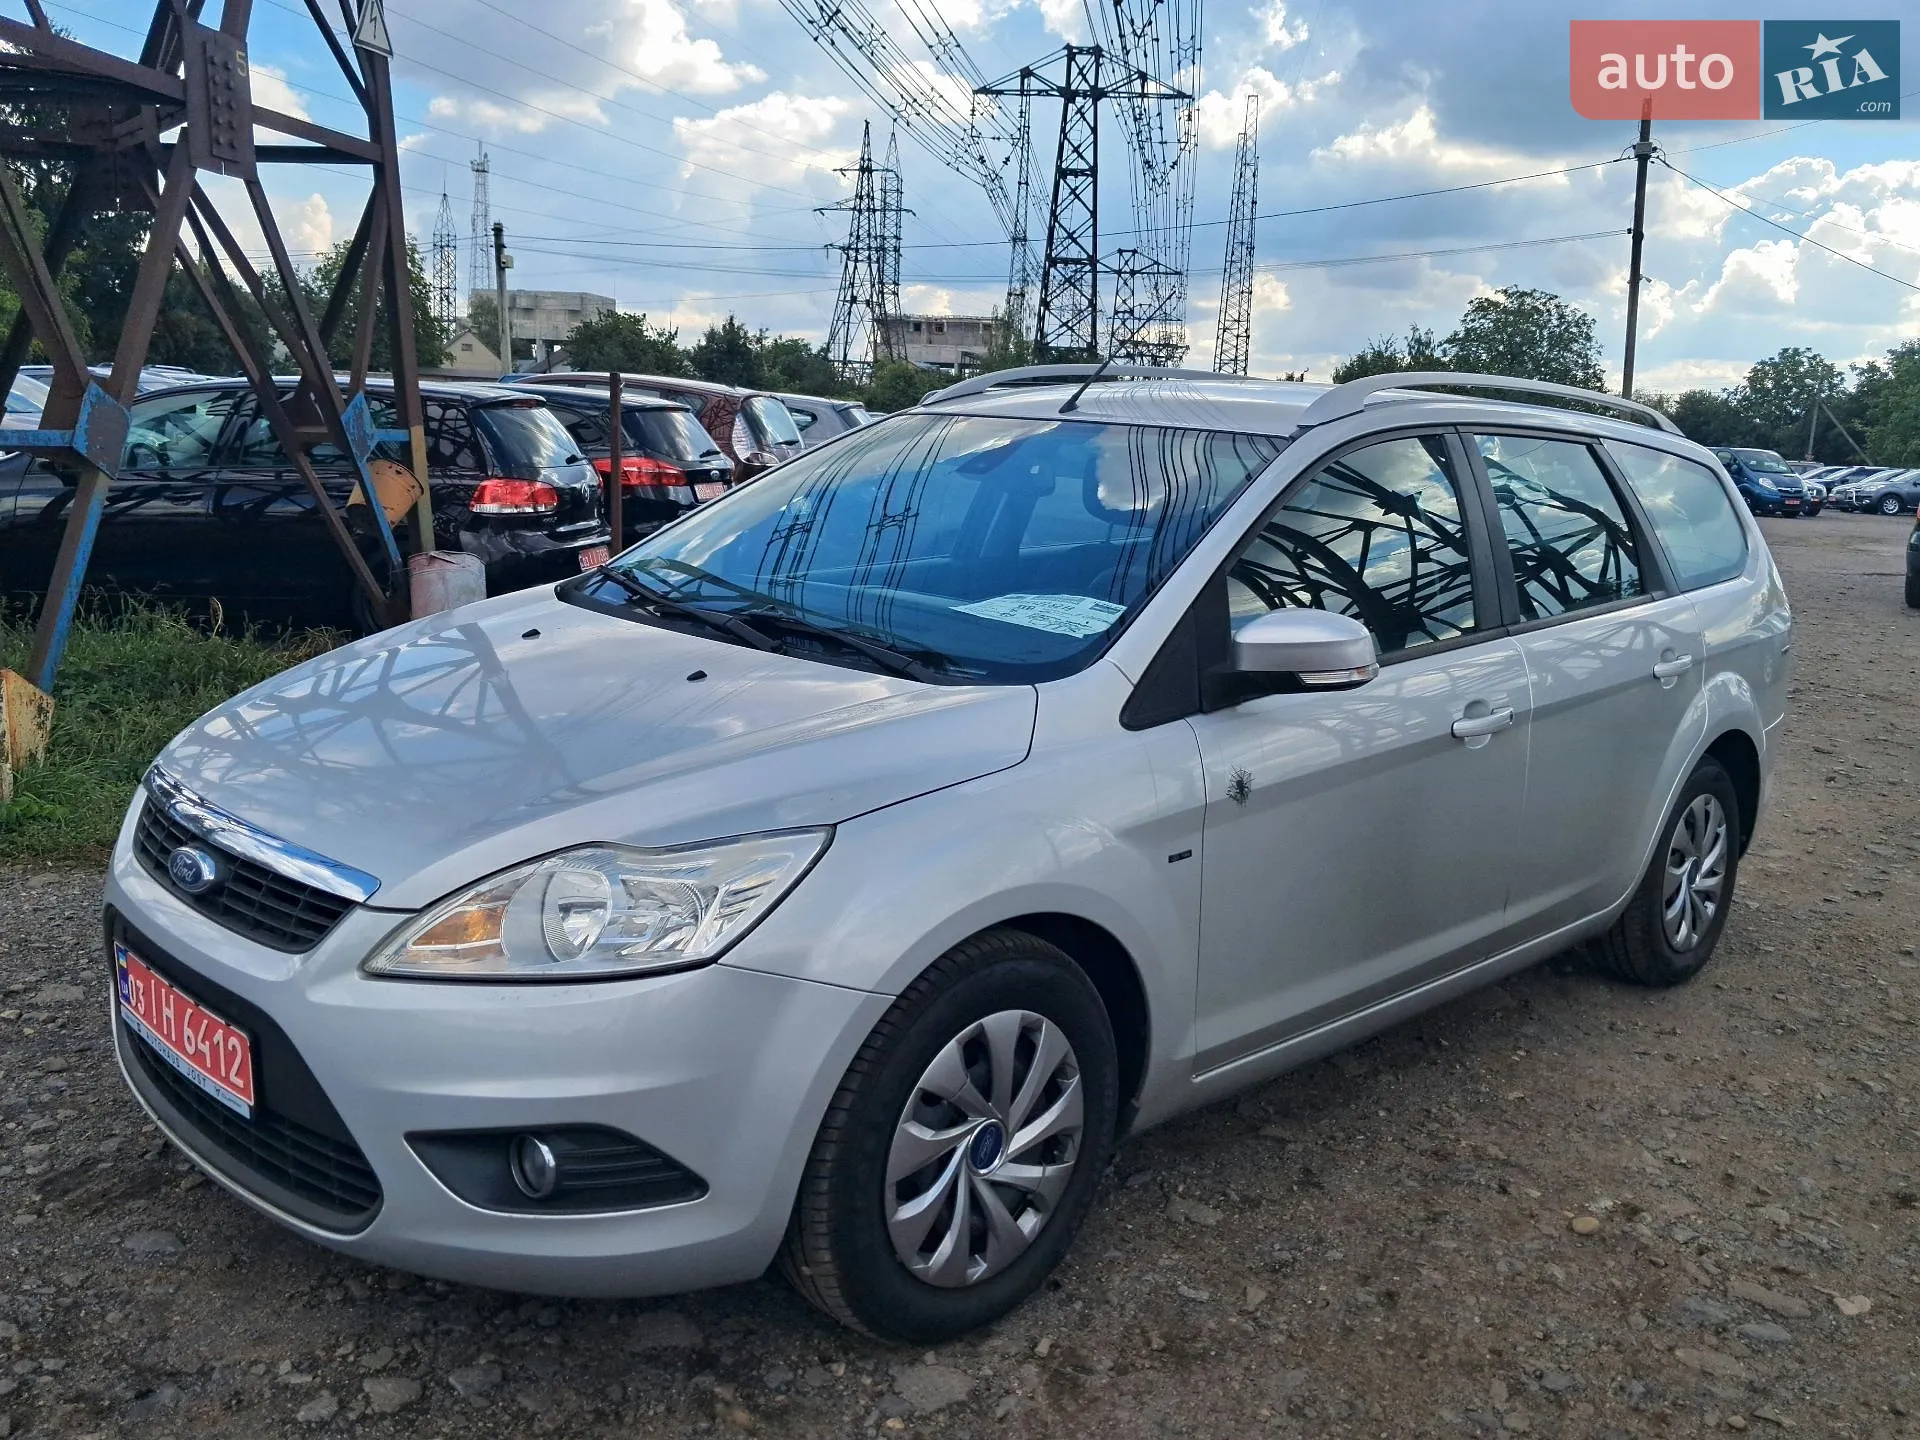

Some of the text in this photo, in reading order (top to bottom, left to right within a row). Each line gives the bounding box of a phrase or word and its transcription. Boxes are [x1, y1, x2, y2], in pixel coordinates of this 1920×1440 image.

[236, 50, 247, 77] 5
[173, 855, 196, 882] Ford
[128, 974, 145, 1015] 03
[184, 1005, 244, 1089] 6412
